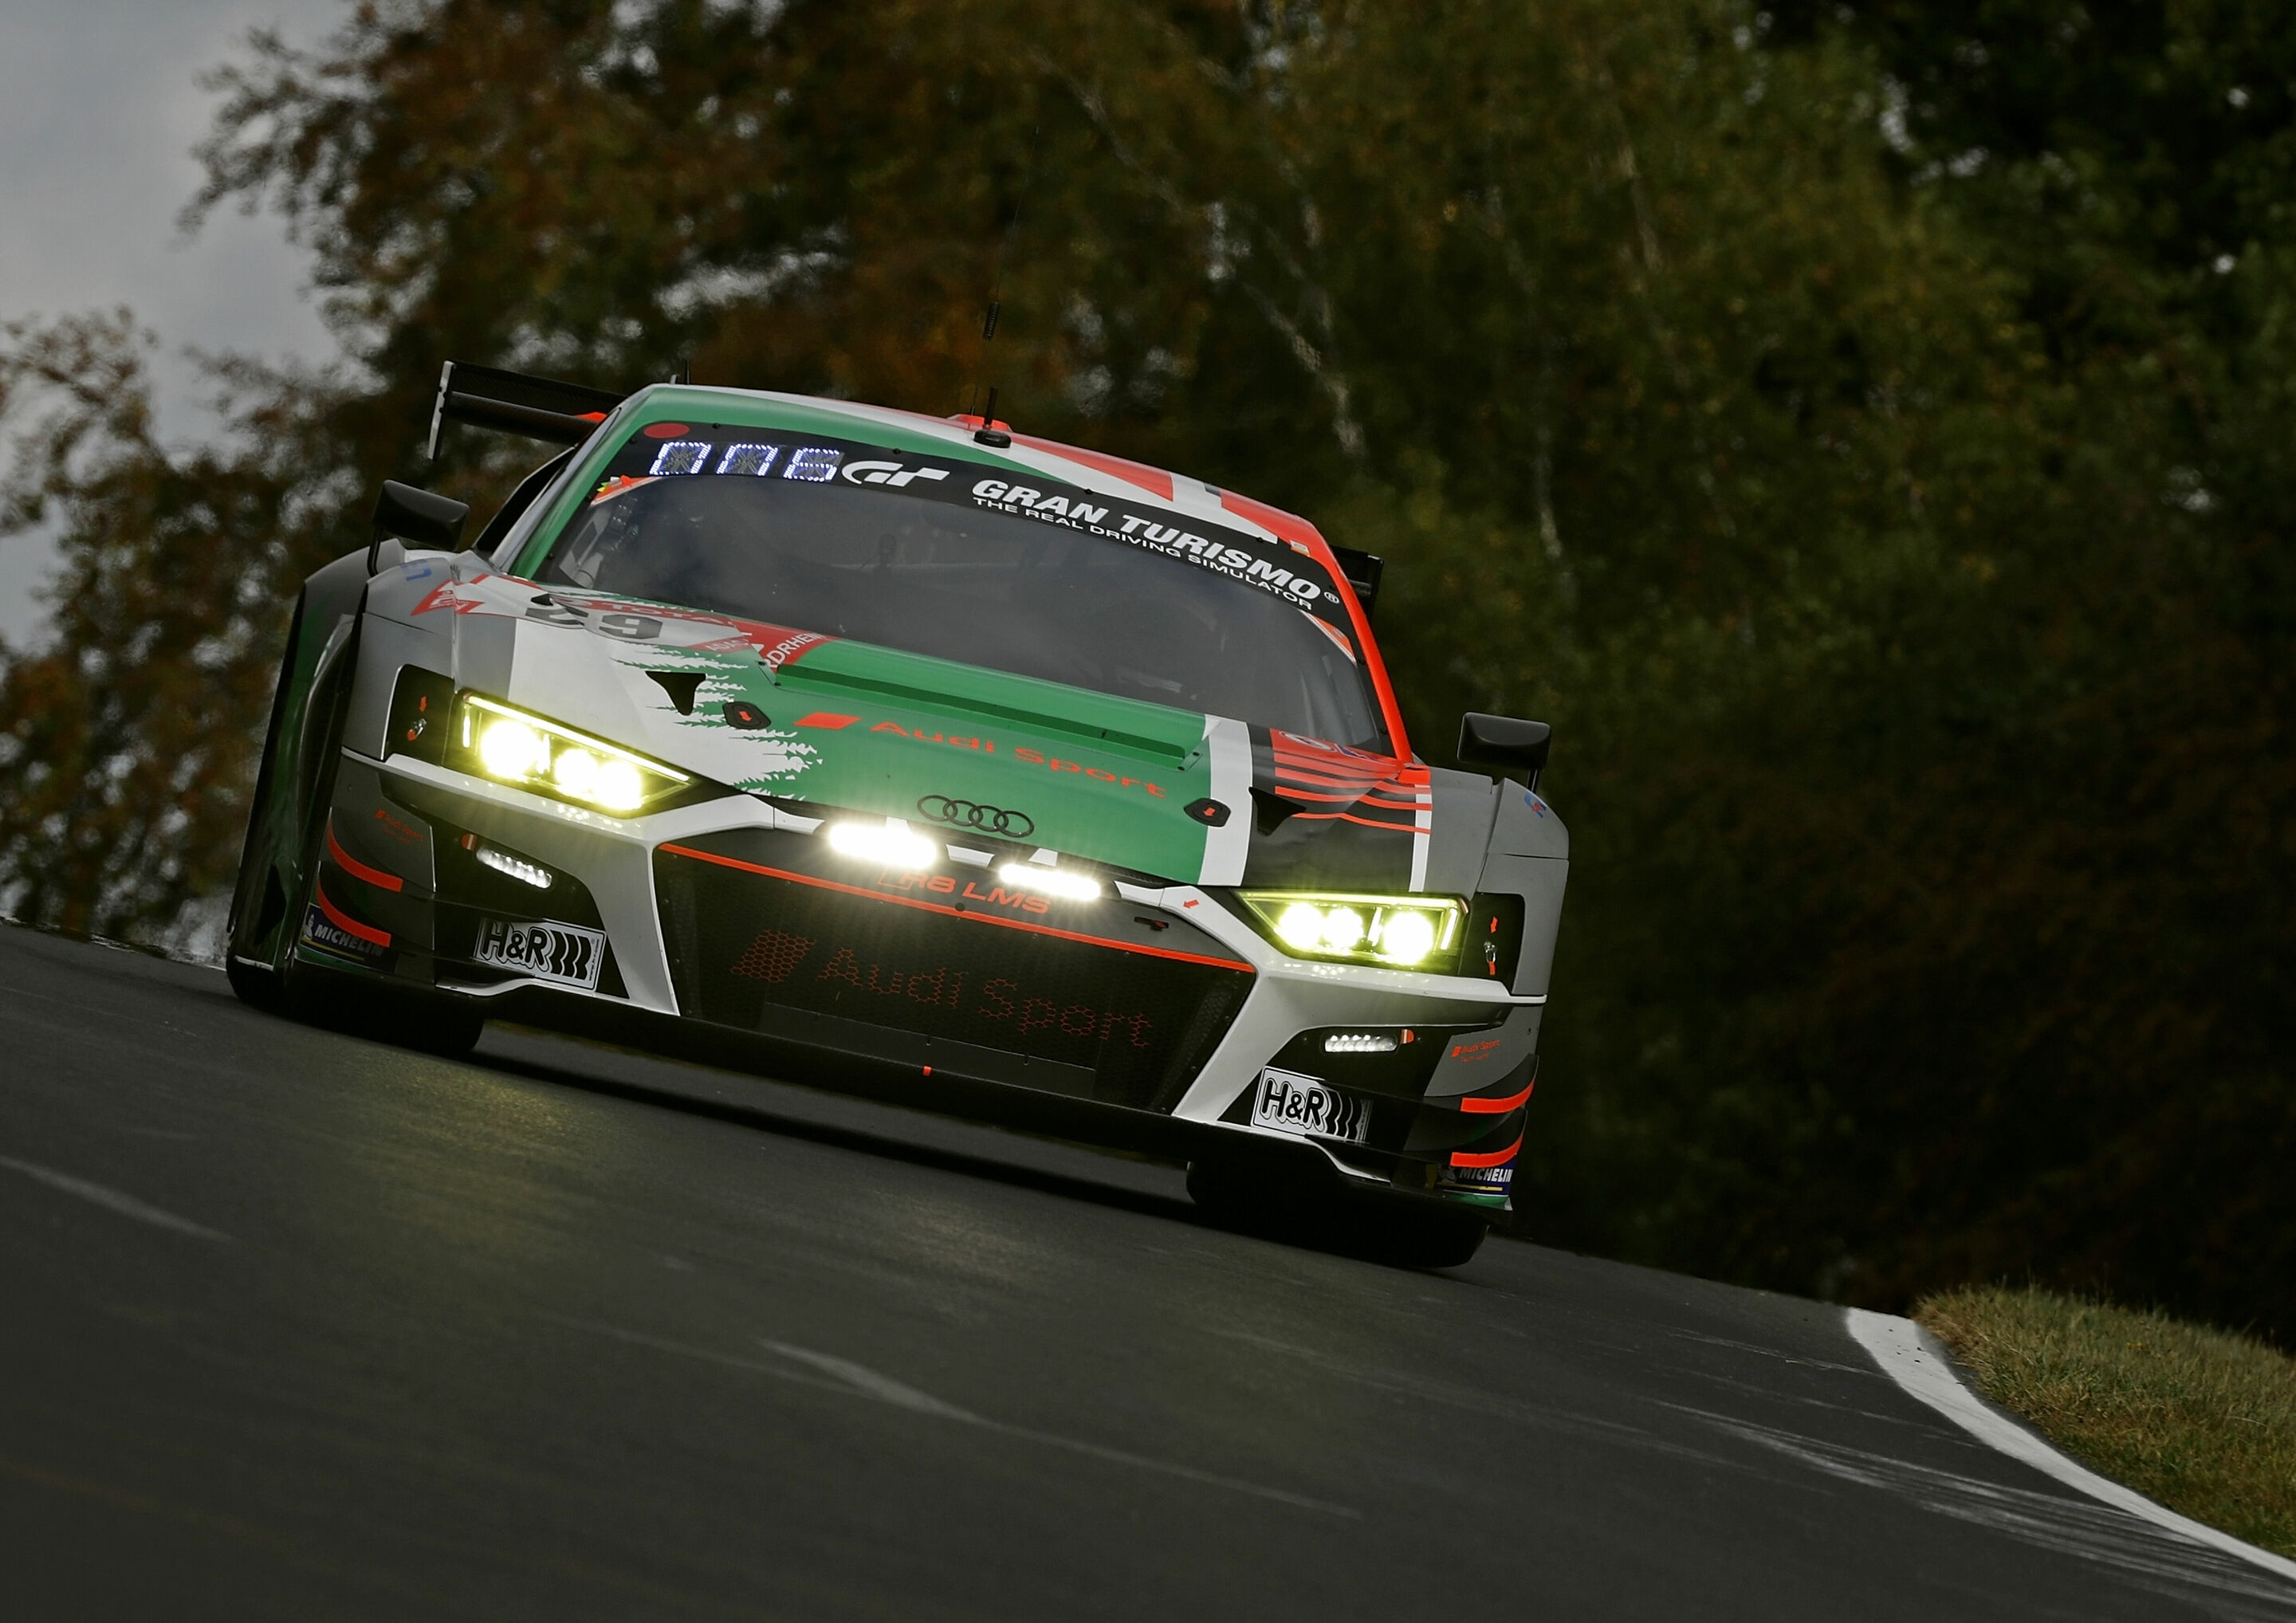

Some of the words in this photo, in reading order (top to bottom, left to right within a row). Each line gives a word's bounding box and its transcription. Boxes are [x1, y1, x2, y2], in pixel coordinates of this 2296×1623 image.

[972, 479, 1109, 524] GRAN
[973, 497, 1019, 514] THE
[1025, 509, 1084, 530] REAL
[1089, 525, 1181, 558] DRIVING
[1187, 554, 1312, 611] SIMULATOR
[870, 721, 995, 753] Audi
[1014, 747, 1167, 799] Sport
[961, 881, 1052, 914] LMS
[313, 924, 384, 957] MICHELIN
[480, 922, 553, 971] H&R
[818, 947, 963, 1008] Audi
[978, 977, 1153, 1048] Sport
[1260, 1079, 1328, 1130] H&R
[1459, 1167, 1514, 1183] MICHELIN
